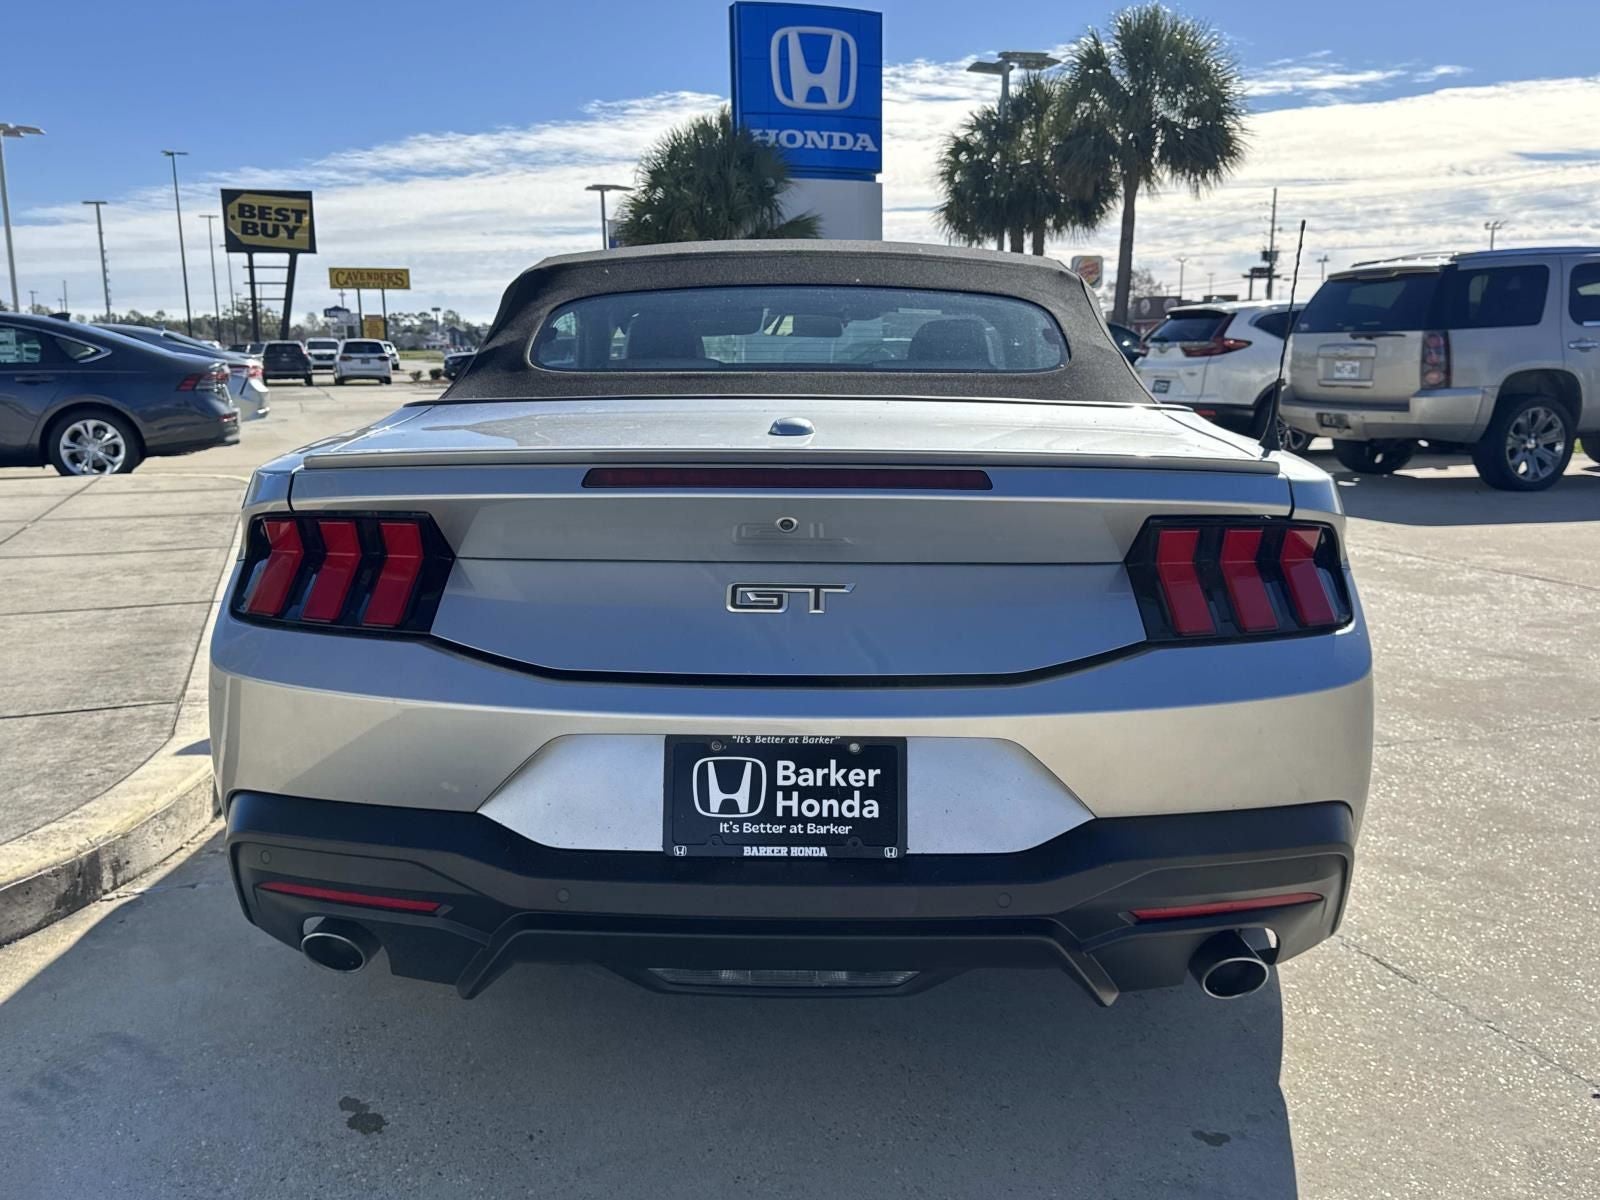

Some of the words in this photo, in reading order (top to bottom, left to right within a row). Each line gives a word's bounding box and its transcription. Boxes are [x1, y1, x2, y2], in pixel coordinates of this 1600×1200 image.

[750, 129, 878, 152] HONDA
[238, 203, 307, 224] BEST
[241, 220, 301, 240] BUY
[335, 270, 405, 287] CAVENDER'S
[726, 582, 856, 614] GT
[755, 735, 785, 744] Better
[788, 736, 798, 744] at
[776, 759, 881, 787] Barker
[776, 791, 880, 818] Honda
[719, 821, 740, 834] It's
[743, 822, 787, 834] Better
[789, 823, 805, 834] at
[807, 823, 853, 835] Barker
[743, 847, 788, 857] BARKER
[790, 847, 828, 857] HONDA
